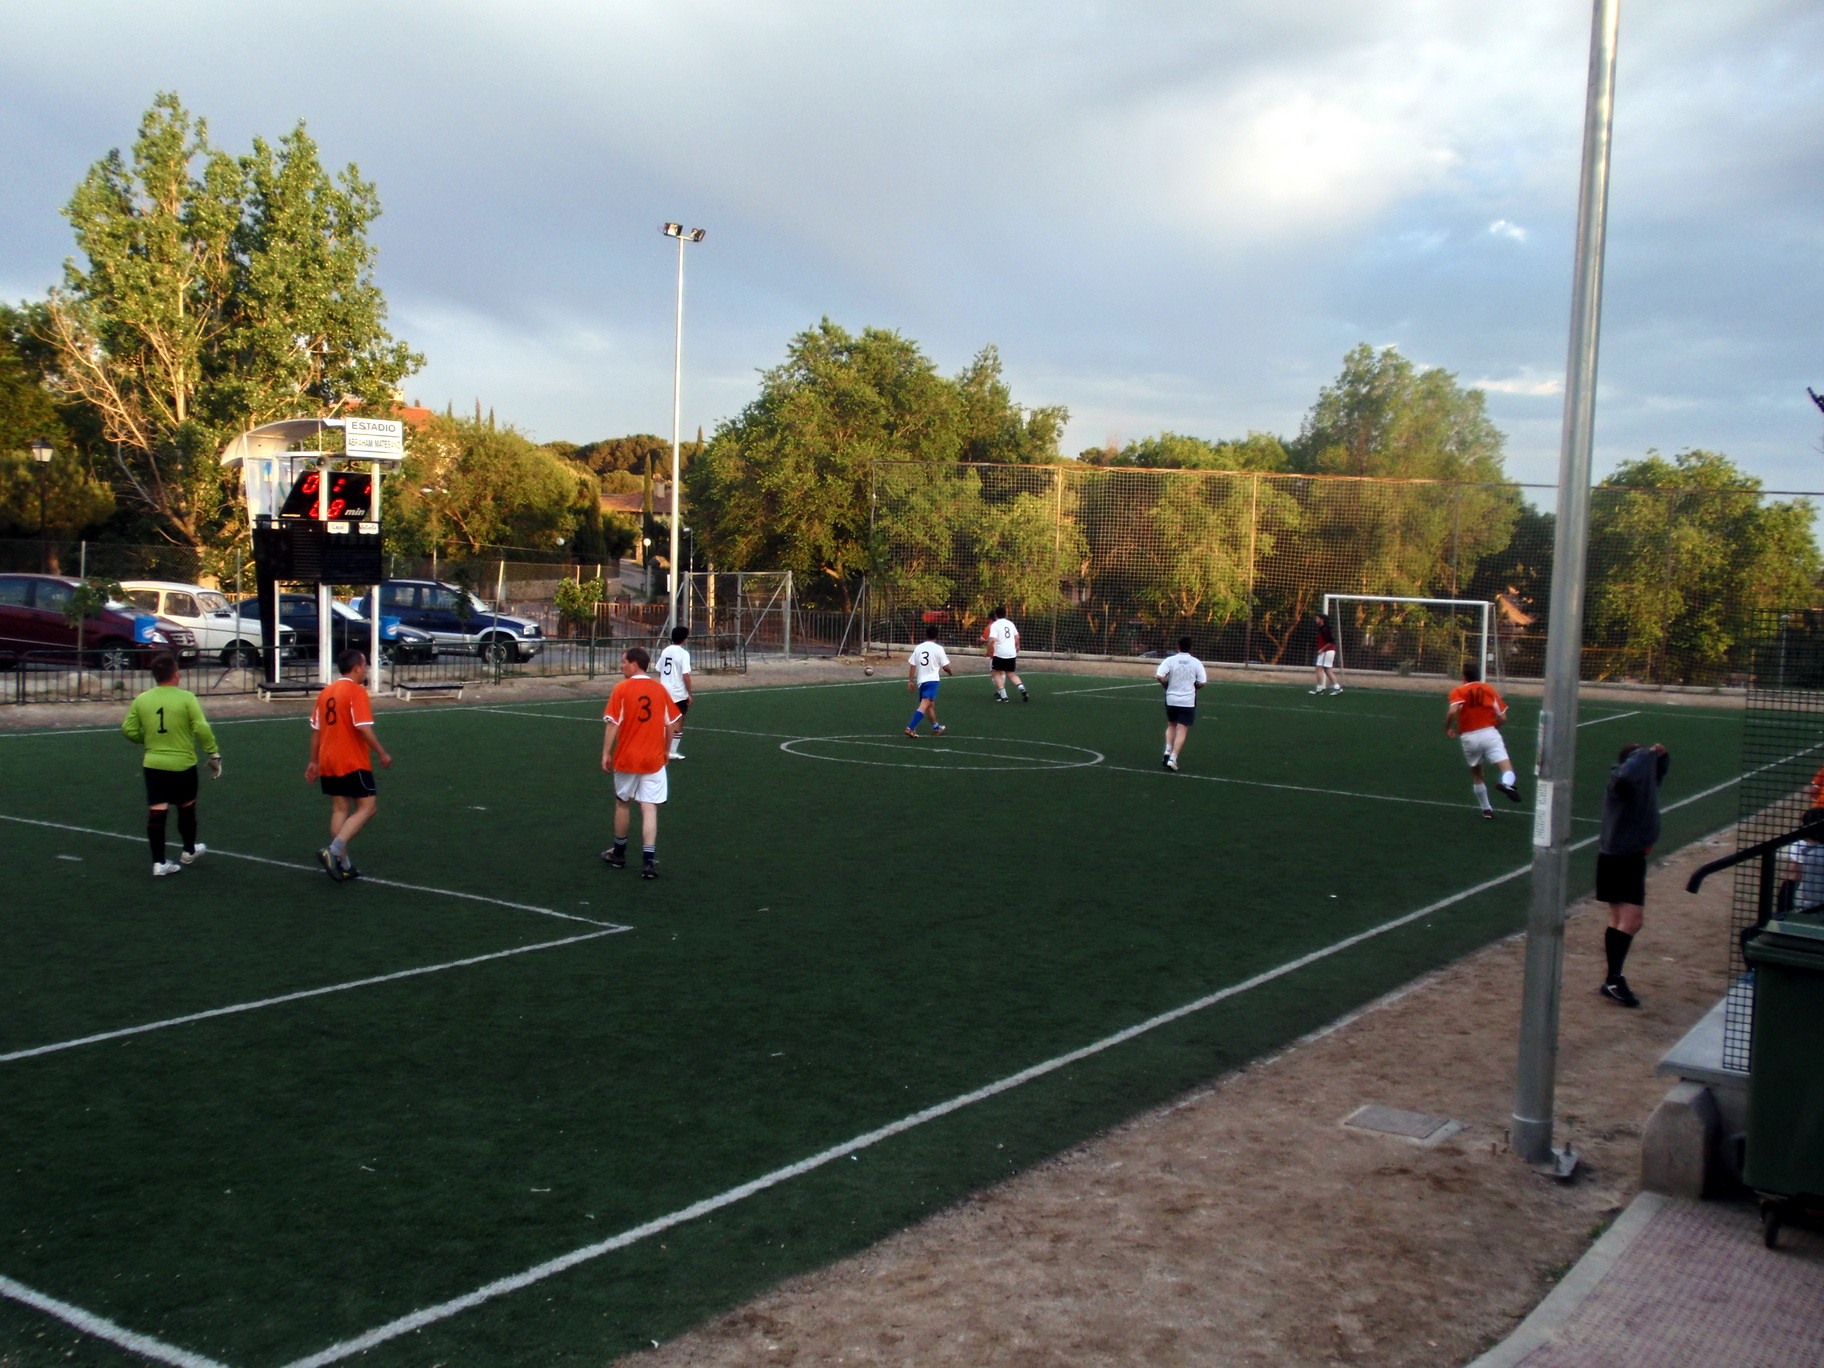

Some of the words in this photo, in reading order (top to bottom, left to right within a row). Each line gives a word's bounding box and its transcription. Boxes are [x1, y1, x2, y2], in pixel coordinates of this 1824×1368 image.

[351, 421, 396, 433] ESTADIO
[344, 508, 365, 516] min
[1004, 626, 1011, 639] 8
[664, 657, 672, 676] 5
[920, 651, 930, 667] 3
[325, 696, 337, 726] 8
[638, 696, 652, 722] 3
[156, 706, 168, 734] 1
